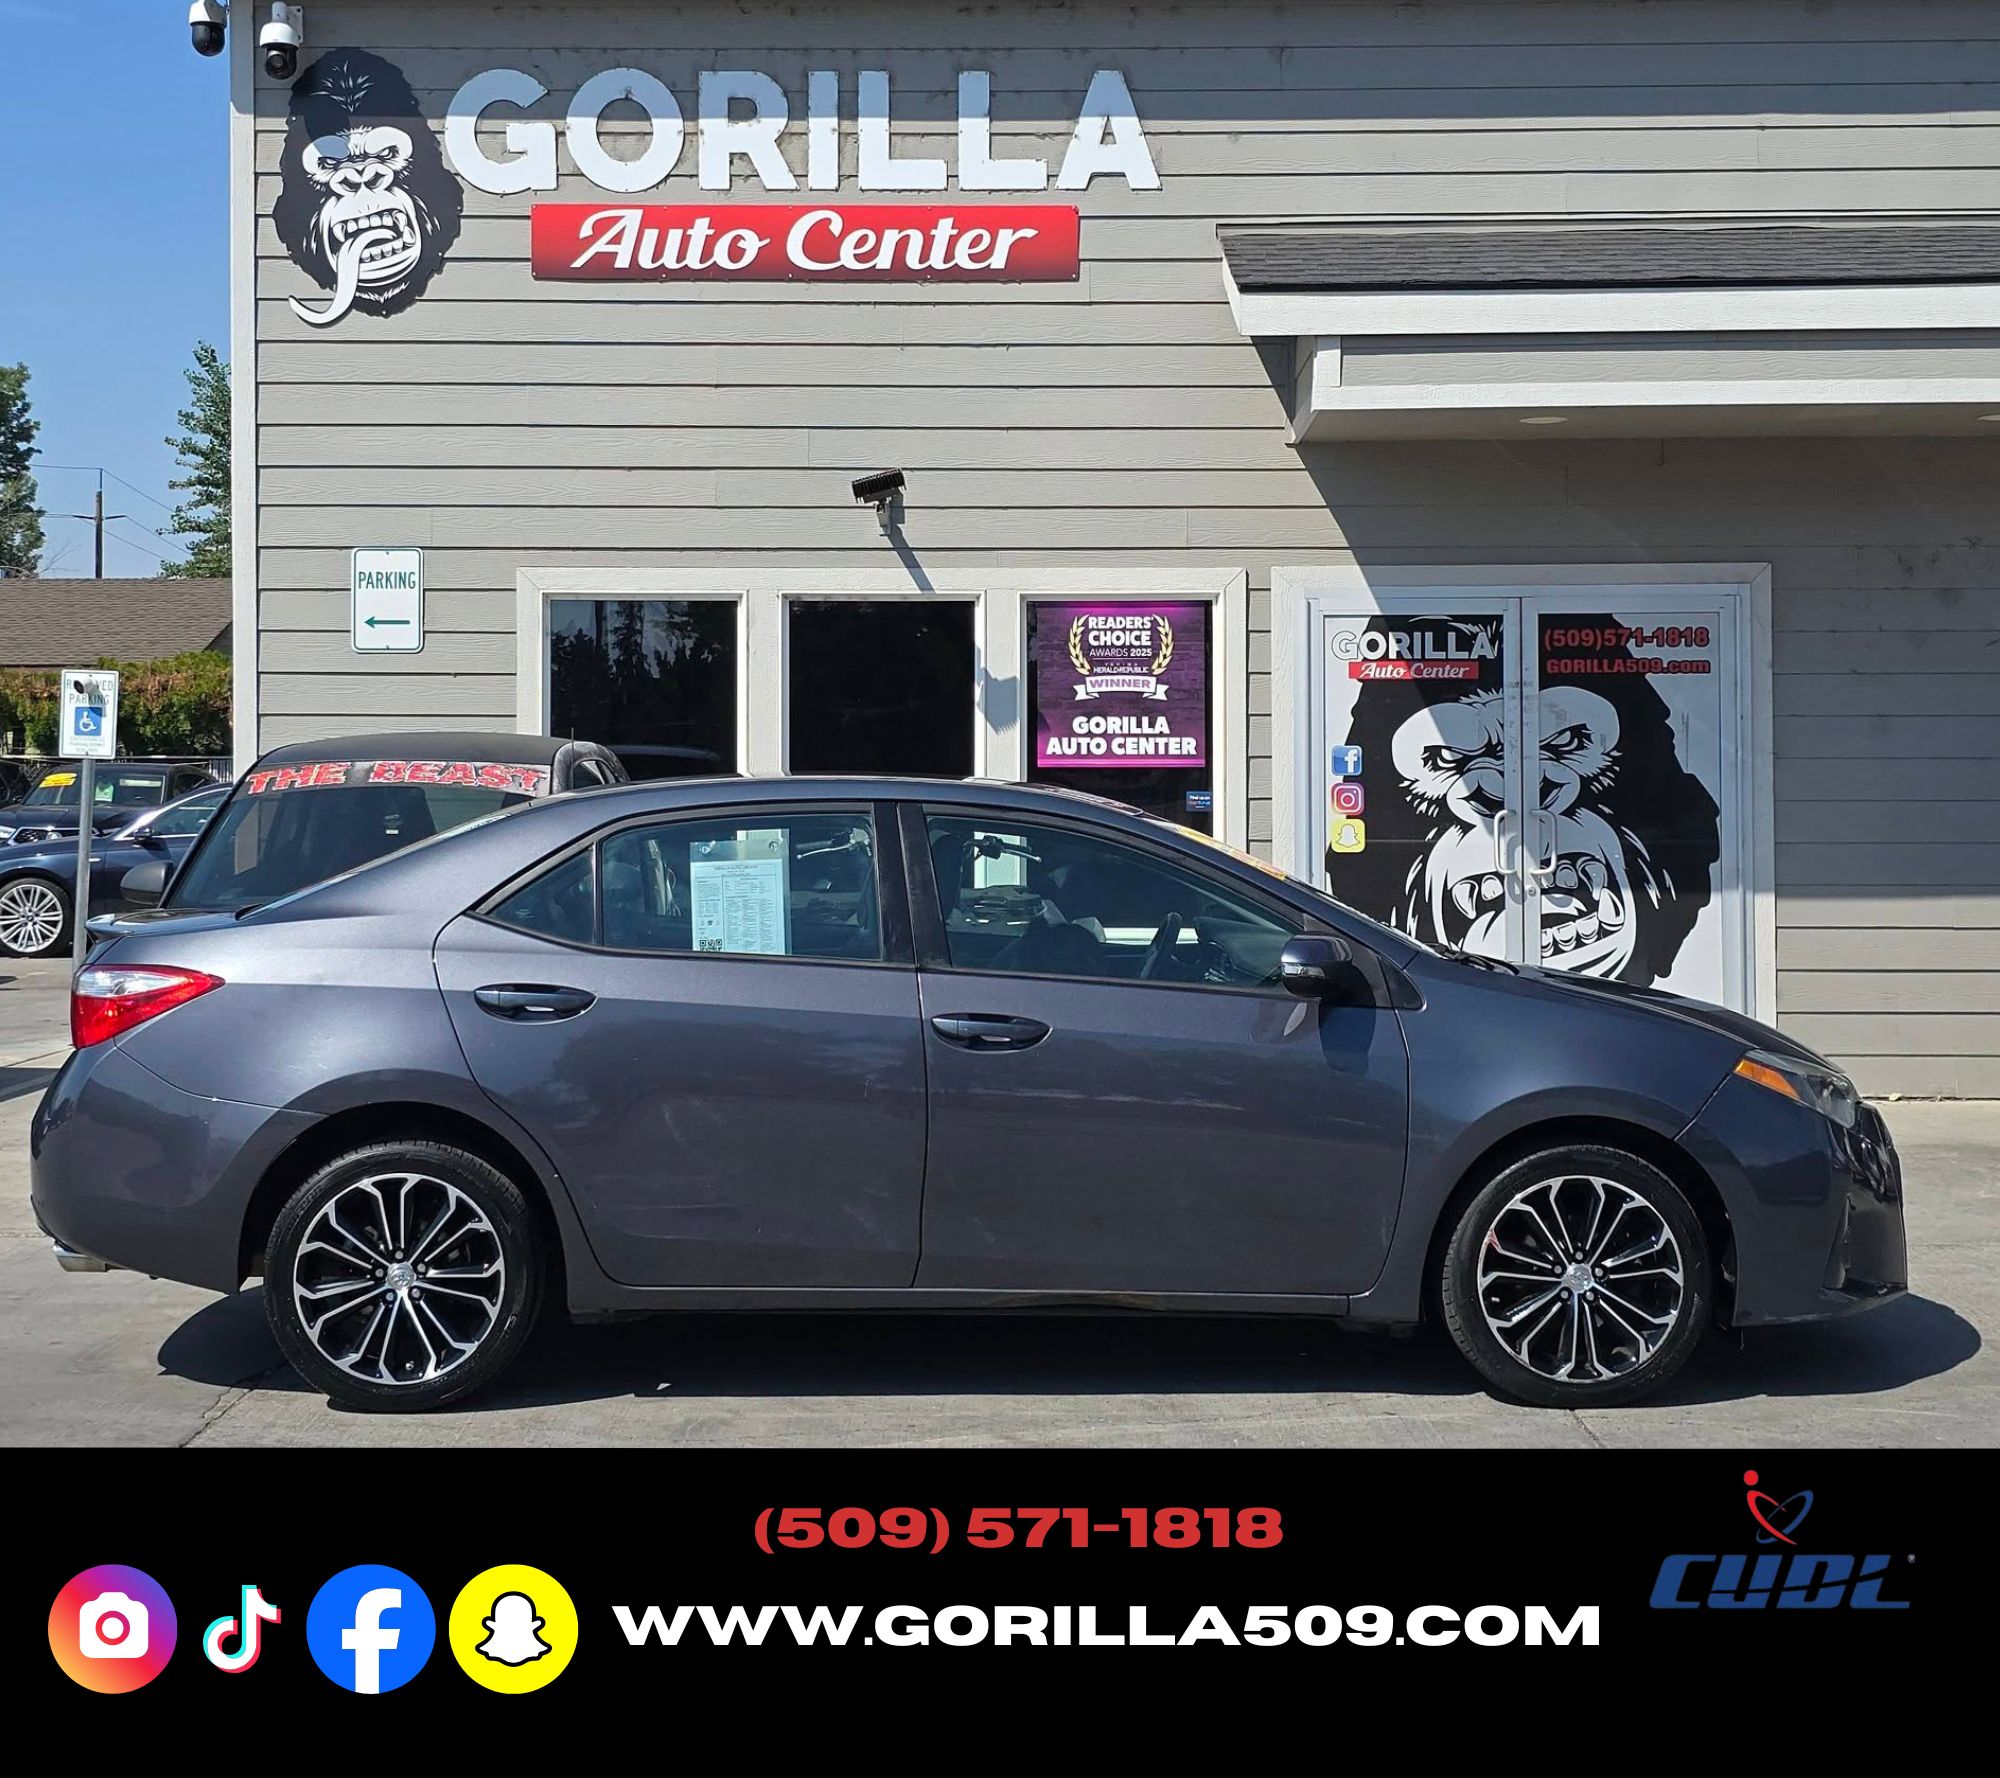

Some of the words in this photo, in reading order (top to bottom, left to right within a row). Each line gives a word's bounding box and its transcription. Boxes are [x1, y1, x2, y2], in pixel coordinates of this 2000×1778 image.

[444, 67, 1163, 195] GORILLA
[570, 208, 771, 271] Auto
[786, 209, 1040, 271] Center
[358, 571, 416, 590] PARKING
[1088, 615, 1154, 630] READERS'
[1088, 630, 1152, 647] CHOICE
[1331, 630, 1495, 661] GORILLA
[1543, 626, 1711, 652] (509)571-1818
[1089, 648, 1129, 657] AWARDS
[1130, 648, 1153, 657] 2025
[1359, 662, 1407, 679] Auto
[1409, 662, 1470, 679] Center
[1546, 657, 1712, 674] GORILLA509.com
[1089, 679, 1151, 689] WINNER
[69, 693, 110, 705] PARKING
[1072, 716, 1170, 735] GORILLA
[1046, 737, 1107, 755] AUTO
[1111, 737, 1197, 755] CENTER
[246, 761, 352, 795] THE
[369, 760, 549, 796] BEAST
